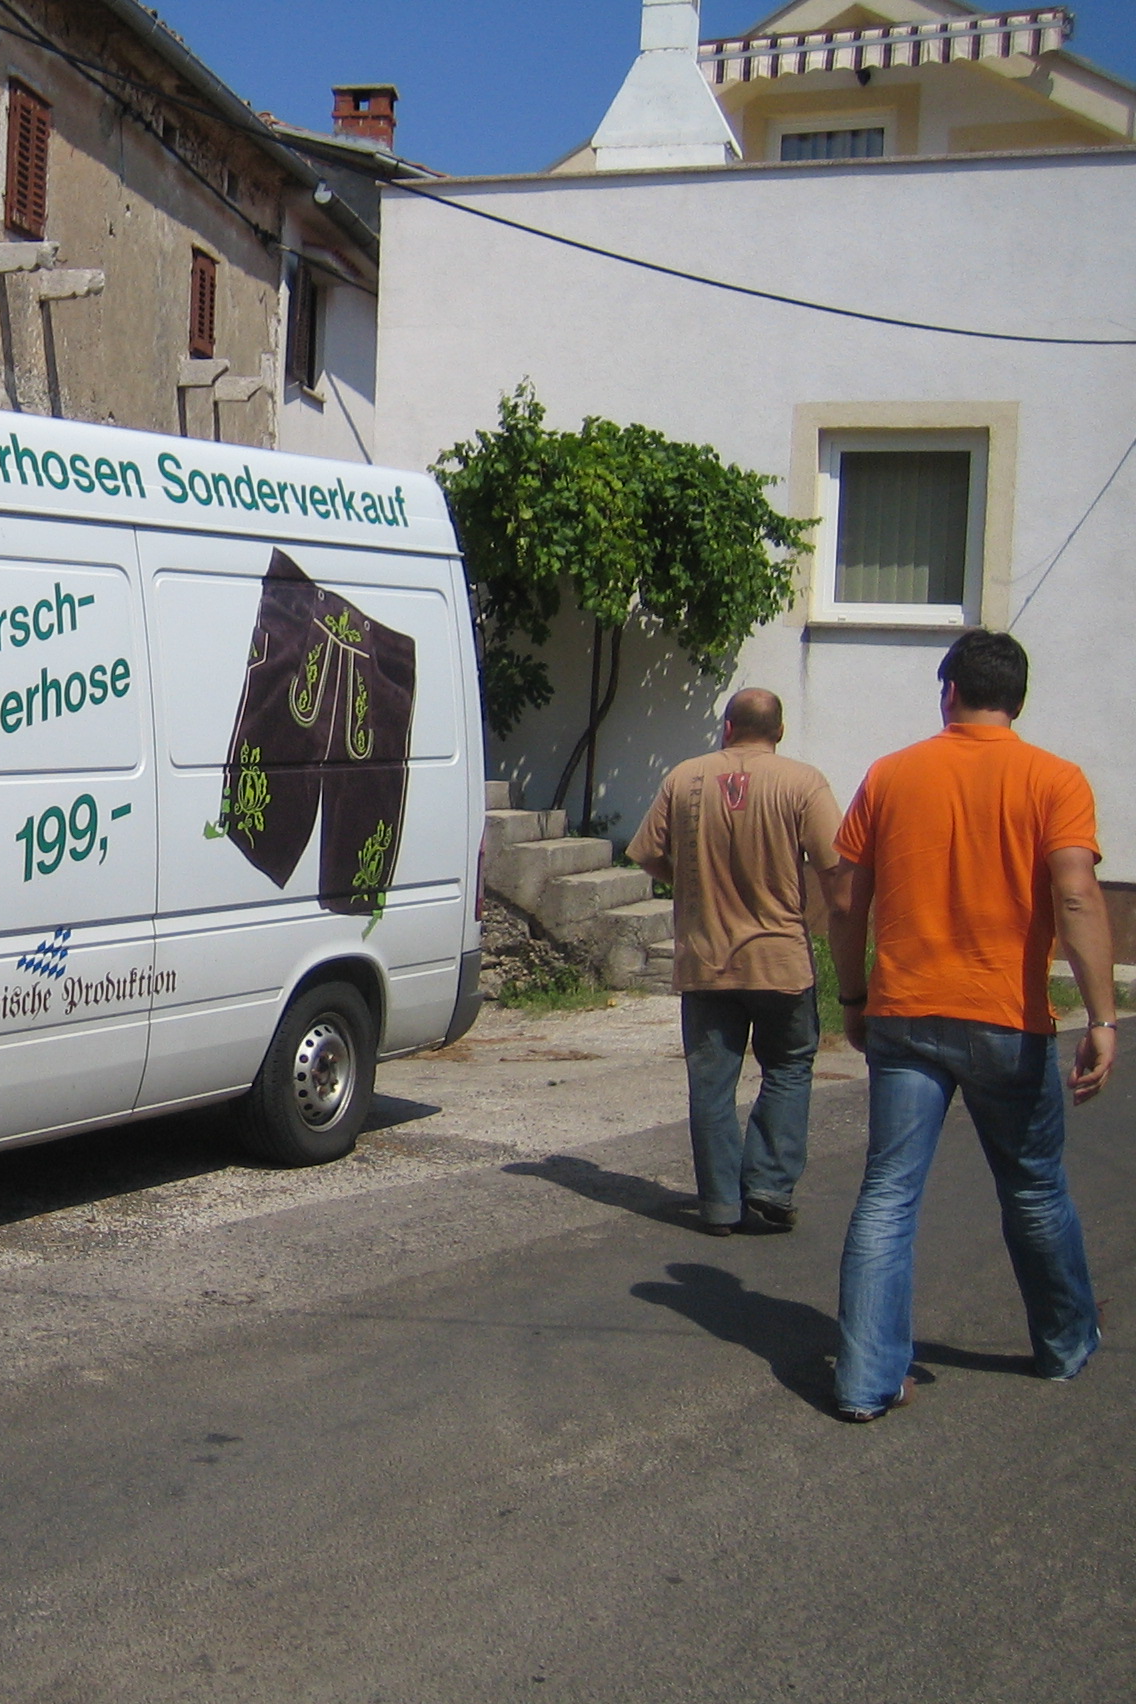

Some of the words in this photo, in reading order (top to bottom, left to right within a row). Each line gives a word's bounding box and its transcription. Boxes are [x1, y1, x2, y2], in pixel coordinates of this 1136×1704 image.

[157, 452, 410, 528] Sonderverkauf
[15, 793, 132, 882] 199,-
[63, 964, 177, 1016] Produktion
